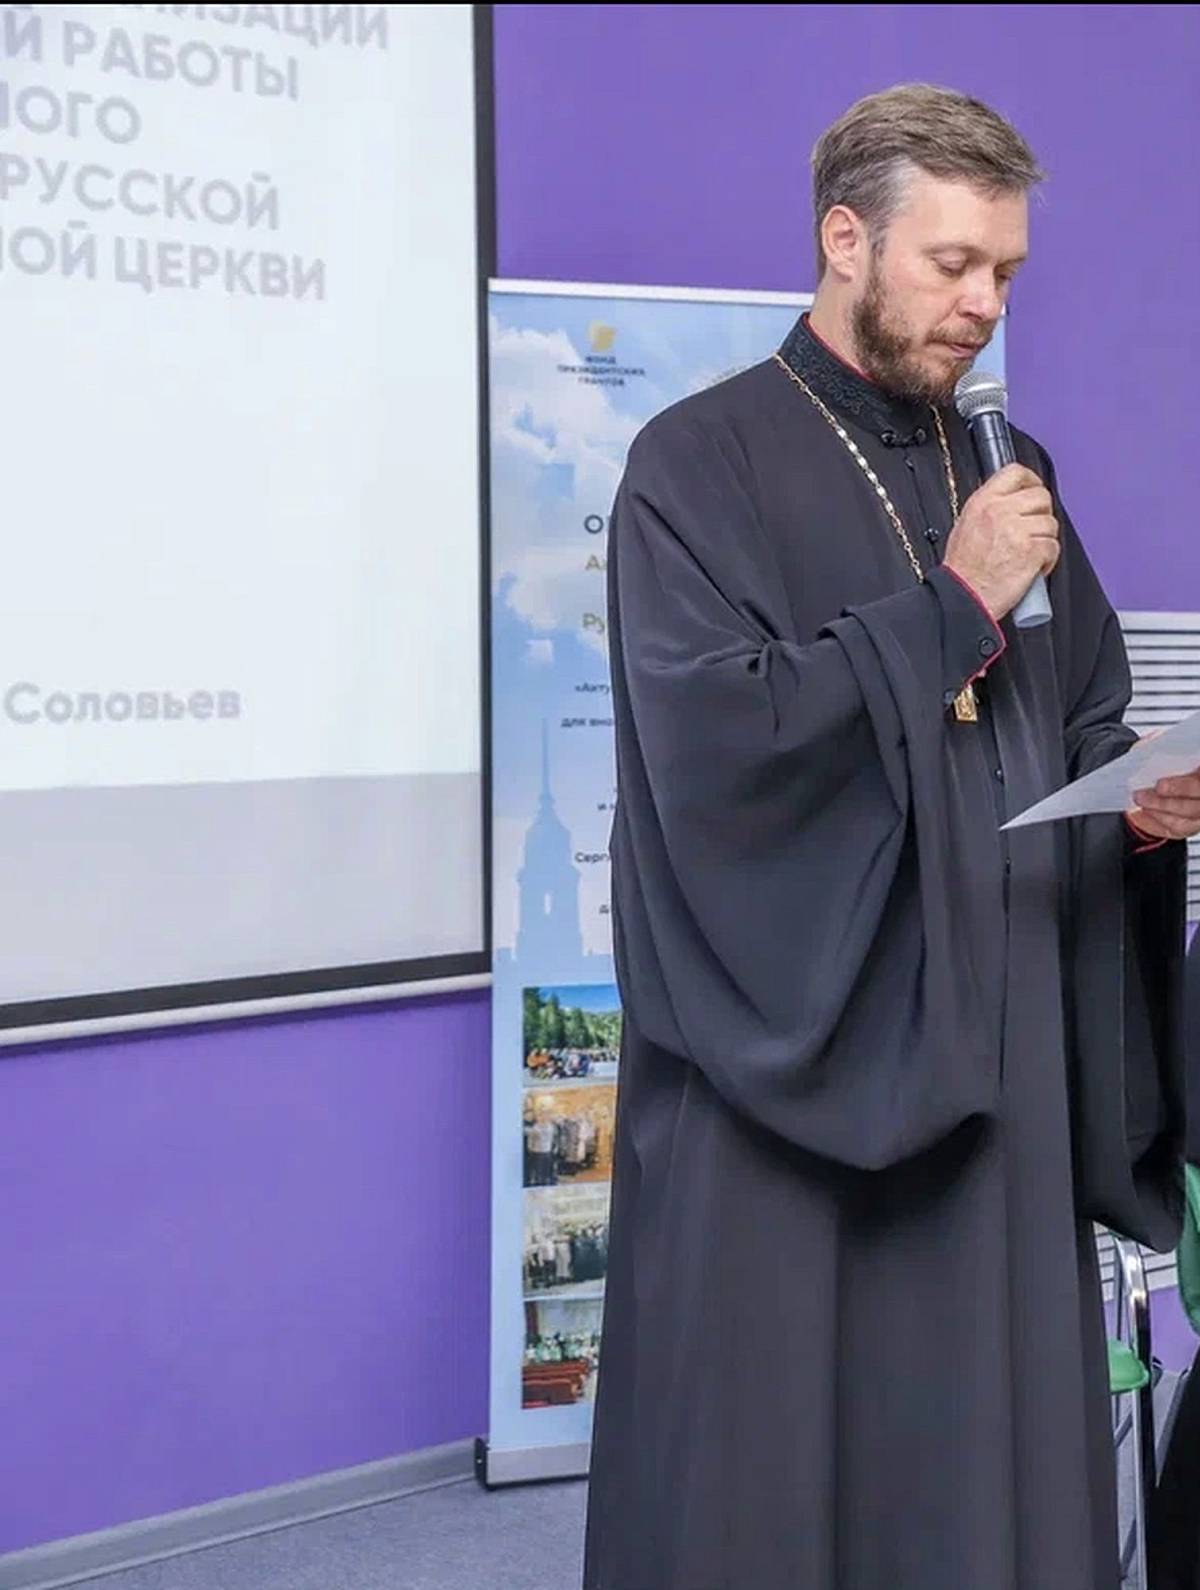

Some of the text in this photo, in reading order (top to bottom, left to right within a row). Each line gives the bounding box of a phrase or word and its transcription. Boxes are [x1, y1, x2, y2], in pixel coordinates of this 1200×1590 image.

[62, 19, 299, 102] РАБОТЫ
[0, 153, 280, 231] РУССКОЙ
[0, 220, 327, 301] ОЙ ЦЕРКВИ
[3, 681, 242, 724] Соловьев
